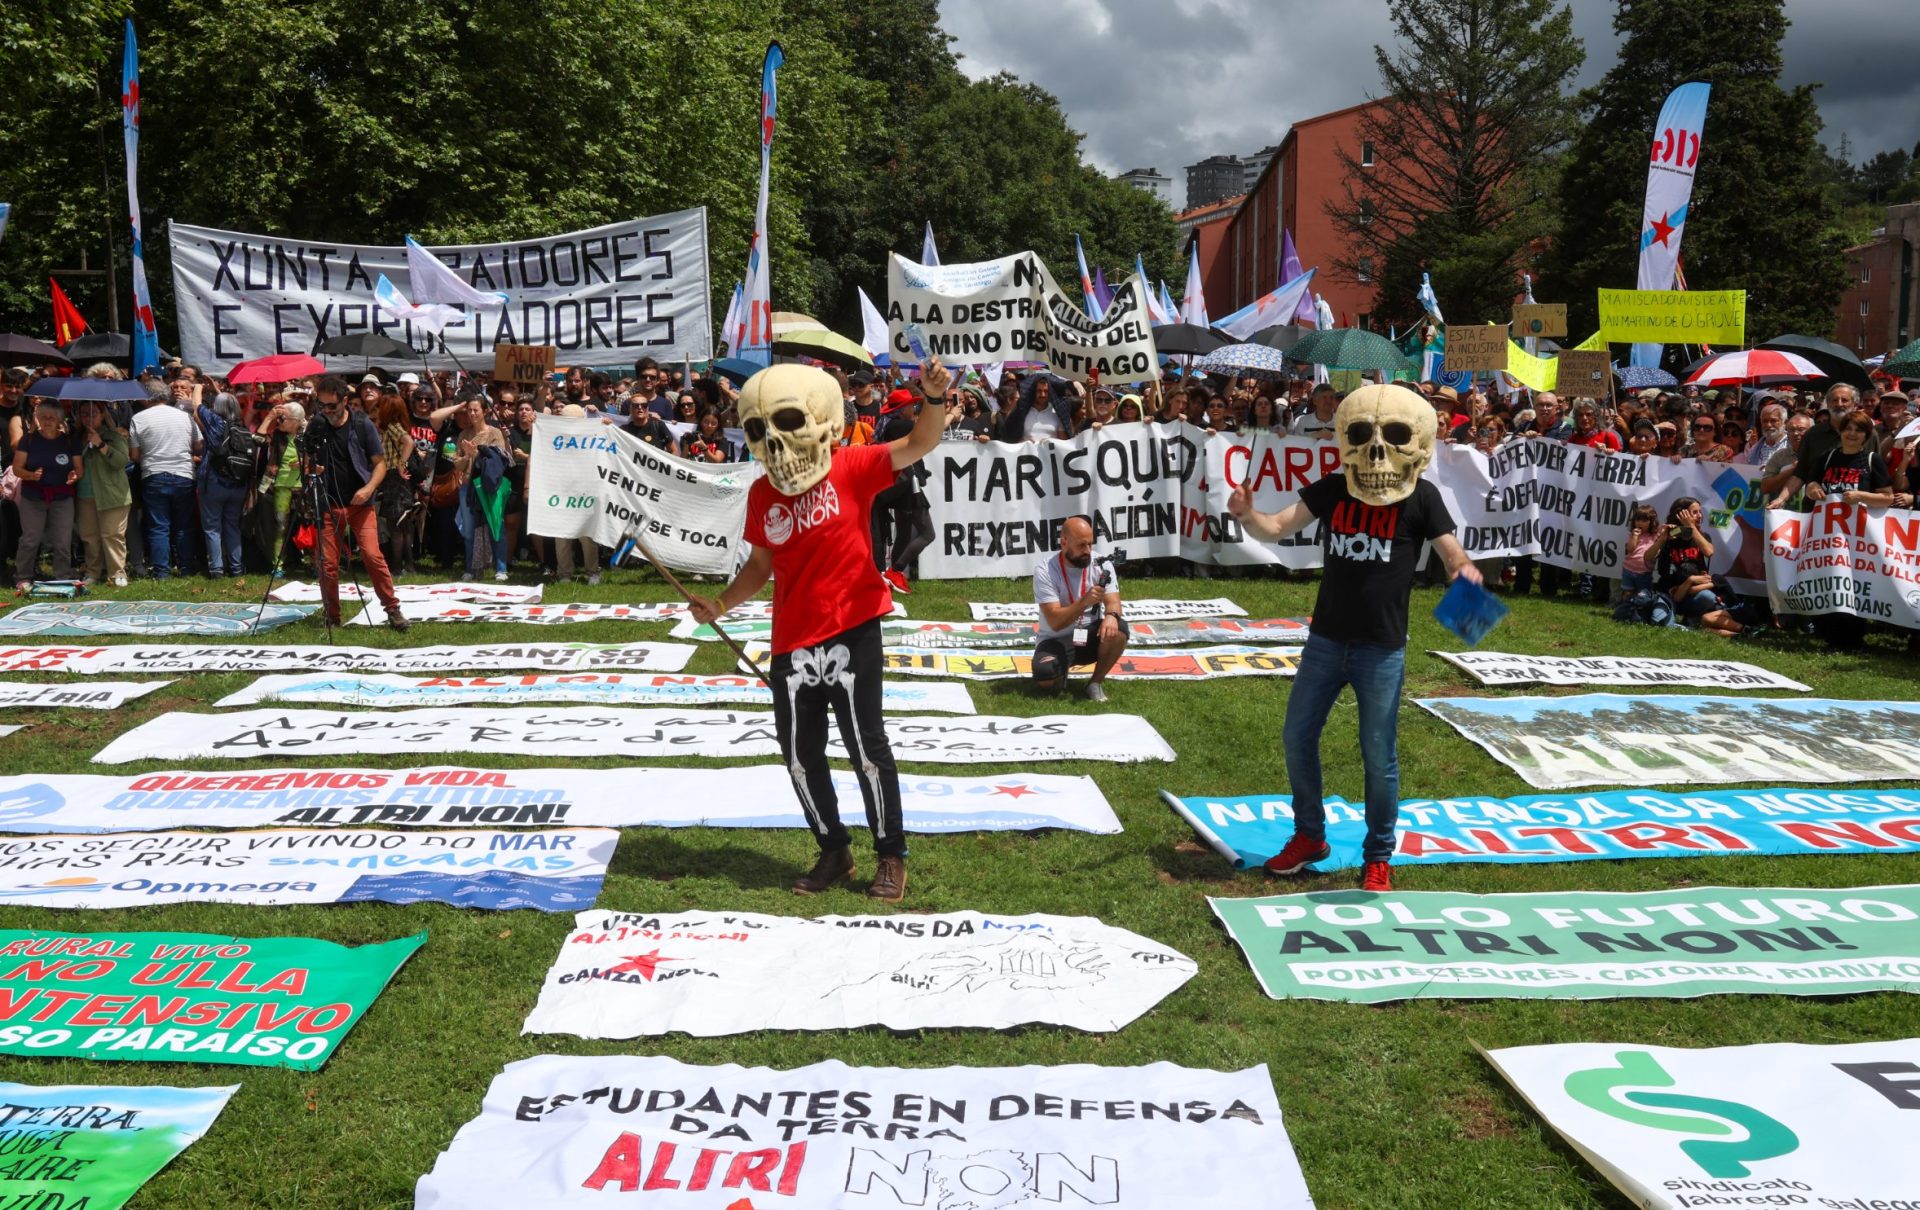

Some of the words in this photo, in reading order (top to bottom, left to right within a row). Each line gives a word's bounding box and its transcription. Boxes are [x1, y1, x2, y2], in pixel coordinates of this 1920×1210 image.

[208, 239, 373, 291] XUNTA
[212, 304, 244, 359] E
[888, 300, 904, 321] A
[911, 302, 943, 325] LA
[1106, 320, 1149, 347] DEL
[1449, 328, 1475, 342] ESTA
[505, 346, 550, 364] ALTRI
[893, 331, 1001, 356] CMINO
[1032, 331, 1150, 377] SNTIAGO
[1447, 357, 1463, 371] DO
[512, 362, 545, 381] NON
[632, 450, 671, 477] NON
[676, 468, 699, 485] SE
[1570, 454, 1586, 478] A
[1592, 453, 1647, 487] TERRA
[596, 465, 663, 503] VENDE
[547, 494, 560, 508] O
[798, 498, 840, 534] NON
[1577, 498, 1592, 522] A
[604, 501, 644, 527] NON
[650, 520, 672, 538] SE
[680, 527, 729, 549] TOCA
[1331, 501, 1400, 539] ALTRI
[1769, 501, 1869, 549] ATRI
[1329, 531, 1393, 563] NON
[1541, 526, 1574, 560] QUE
[1578, 535, 1618, 568] NOS
[1856, 540, 1879, 556] DO
[1855, 558, 1877, 574] DA
[1853, 580, 1872, 597] DE
[623, 729, 706, 745] de
[128, 772, 394, 791] QUEREMOS
[103, 787, 378, 811] QUEREMOS
[273, 803, 437, 825] ALTRI
[437, 803, 572, 824] NON!
[1206, 800, 1295, 828] NA
[1323, 796, 1635, 827] DFENSA
[1627, 794, 1747, 820] DA
[72, 836, 231, 854] SEGUIR
[248, 833, 407, 850] VIVINDO
[488, 834, 577, 851] MAR
[1399, 822, 1752, 857] ALTRI
[267, 851, 576, 871] saneadas
[111, 877, 319, 896] Opmega
[931, 919, 975, 938] DA
[1253, 901, 1512, 929] POLO
[1531, 898, 1920, 930] FUTURO
[1, 937, 136, 959] RURAL
[150, 943, 251, 960] VIVO
[1279, 927, 1561, 956] ALTRI
[1574, 925, 1860, 955] NON!
[130, 960, 310, 996] ULLA
[558, 967, 642, 985] GALIZA
[0, 986, 355, 1035] NTENSIVO
[78, 1026, 330, 1062] PARAÍSO
[515, 1086, 872, 1122] ESTUDANTES
[892, 1094, 966, 1124] EN
[988, 1093, 1266, 1126] DEFENSA
[669, 1113, 753, 1142] DA
[776, 1118, 967, 1142] TERRA
[580, 1130, 808, 1197] ALTRI
[844, 1146, 1120, 1210] NON
[1662, 1175, 1814, 1193] sindicato
[1675, 1192, 1810, 1208] labrego
